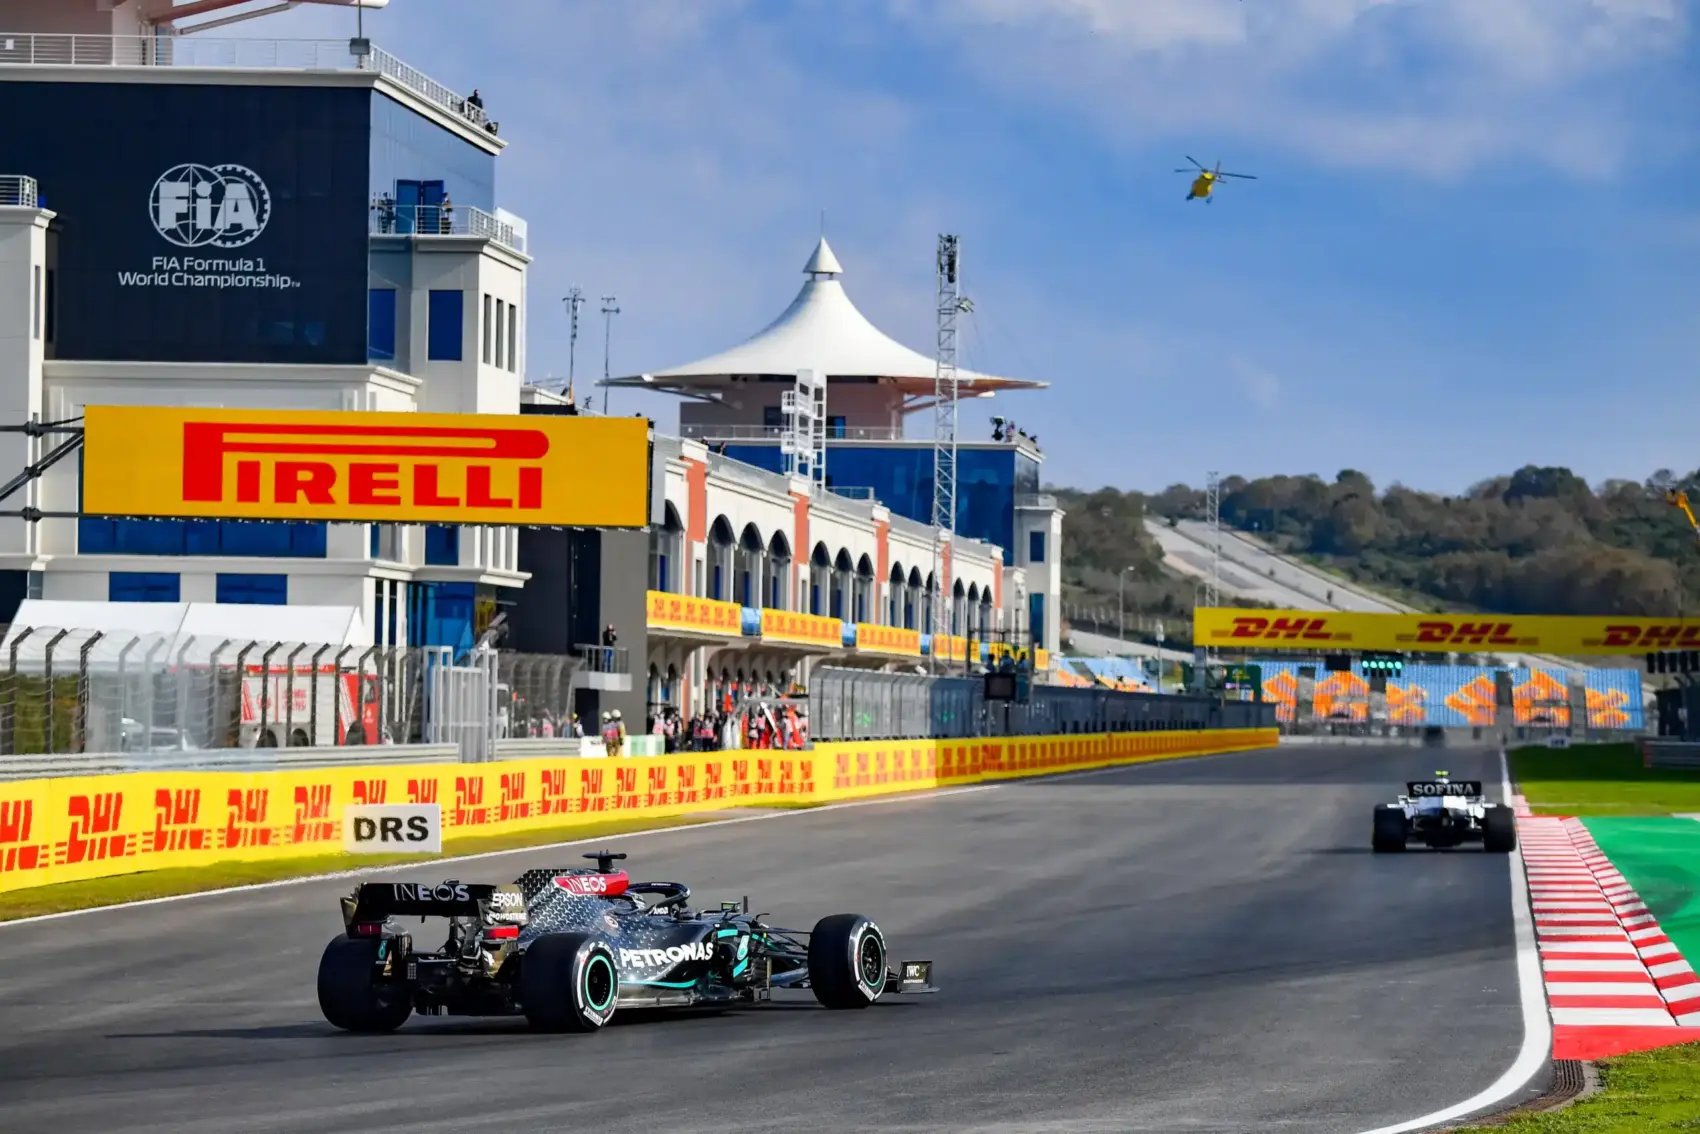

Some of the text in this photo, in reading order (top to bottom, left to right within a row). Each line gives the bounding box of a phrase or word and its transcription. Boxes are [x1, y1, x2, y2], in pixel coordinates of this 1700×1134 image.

[152, 257, 266, 272] FIA Formula 1
[118, 272, 168, 286] World
[171, 272, 291, 289] Championship
[182, 421, 550, 509] PIRELLI
[1232, 617, 1700, 647] DHL DHL DHL
[1413, 783, 1474, 796] SOFINA
[66, 792, 127, 864] DHL
[153, 788, 205, 852] DHL
[354, 815, 429, 842] DRS
[393, 883, 470, 902] INEOS
[566, 877, 607, 893] INEOS
[491, 892, 523, 907] EPSON
[618, 942, 714, 969] PETRONAS
[906, 965, 920, 978] IWC
